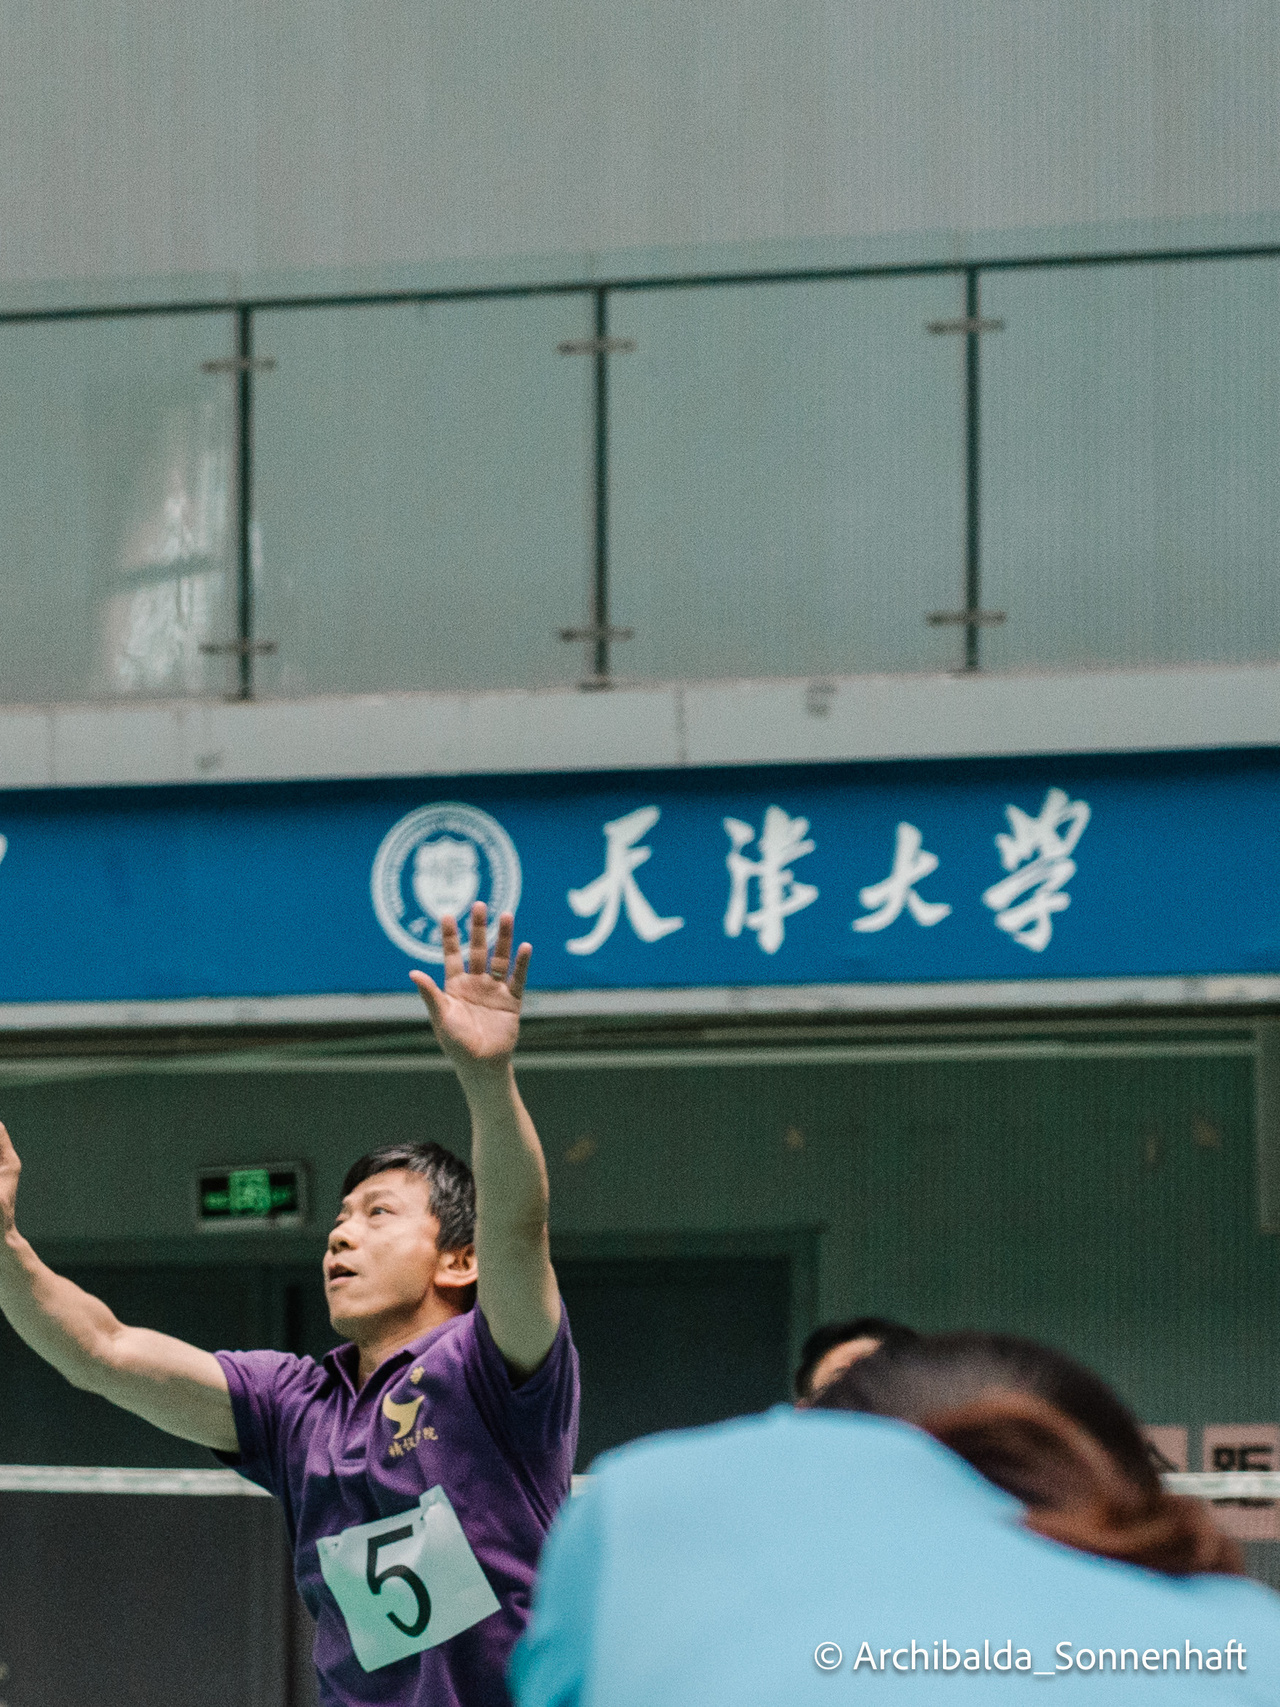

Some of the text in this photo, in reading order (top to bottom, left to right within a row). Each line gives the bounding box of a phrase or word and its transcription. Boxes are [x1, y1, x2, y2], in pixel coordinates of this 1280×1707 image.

[566, 787, 1091, 954] 天津大学
[366, 1523, 432, 1638] 5
